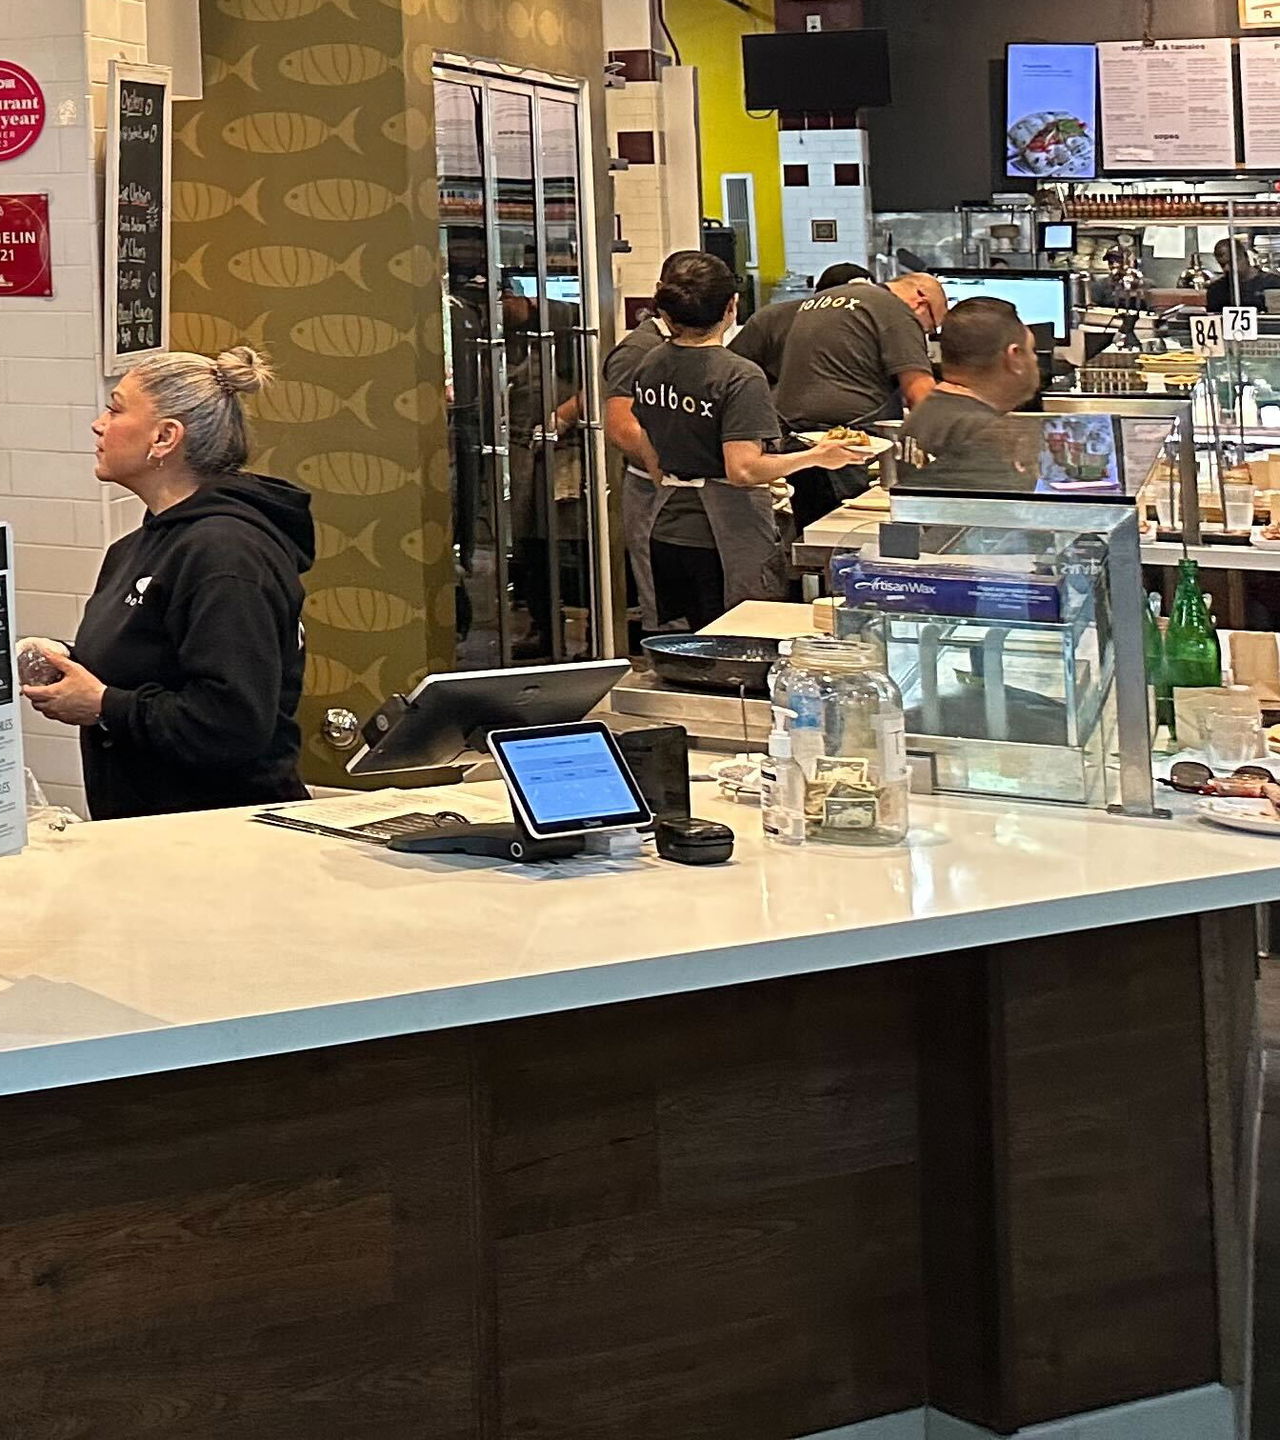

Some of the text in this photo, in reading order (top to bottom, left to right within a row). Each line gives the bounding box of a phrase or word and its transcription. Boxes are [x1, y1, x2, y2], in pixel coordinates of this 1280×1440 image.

[0, 113, 40, 130] year
[1195, 319, 1219, 346] 84
[1228, 309, 1252, 332] 75
[635, 380, 714, 419] holbox
